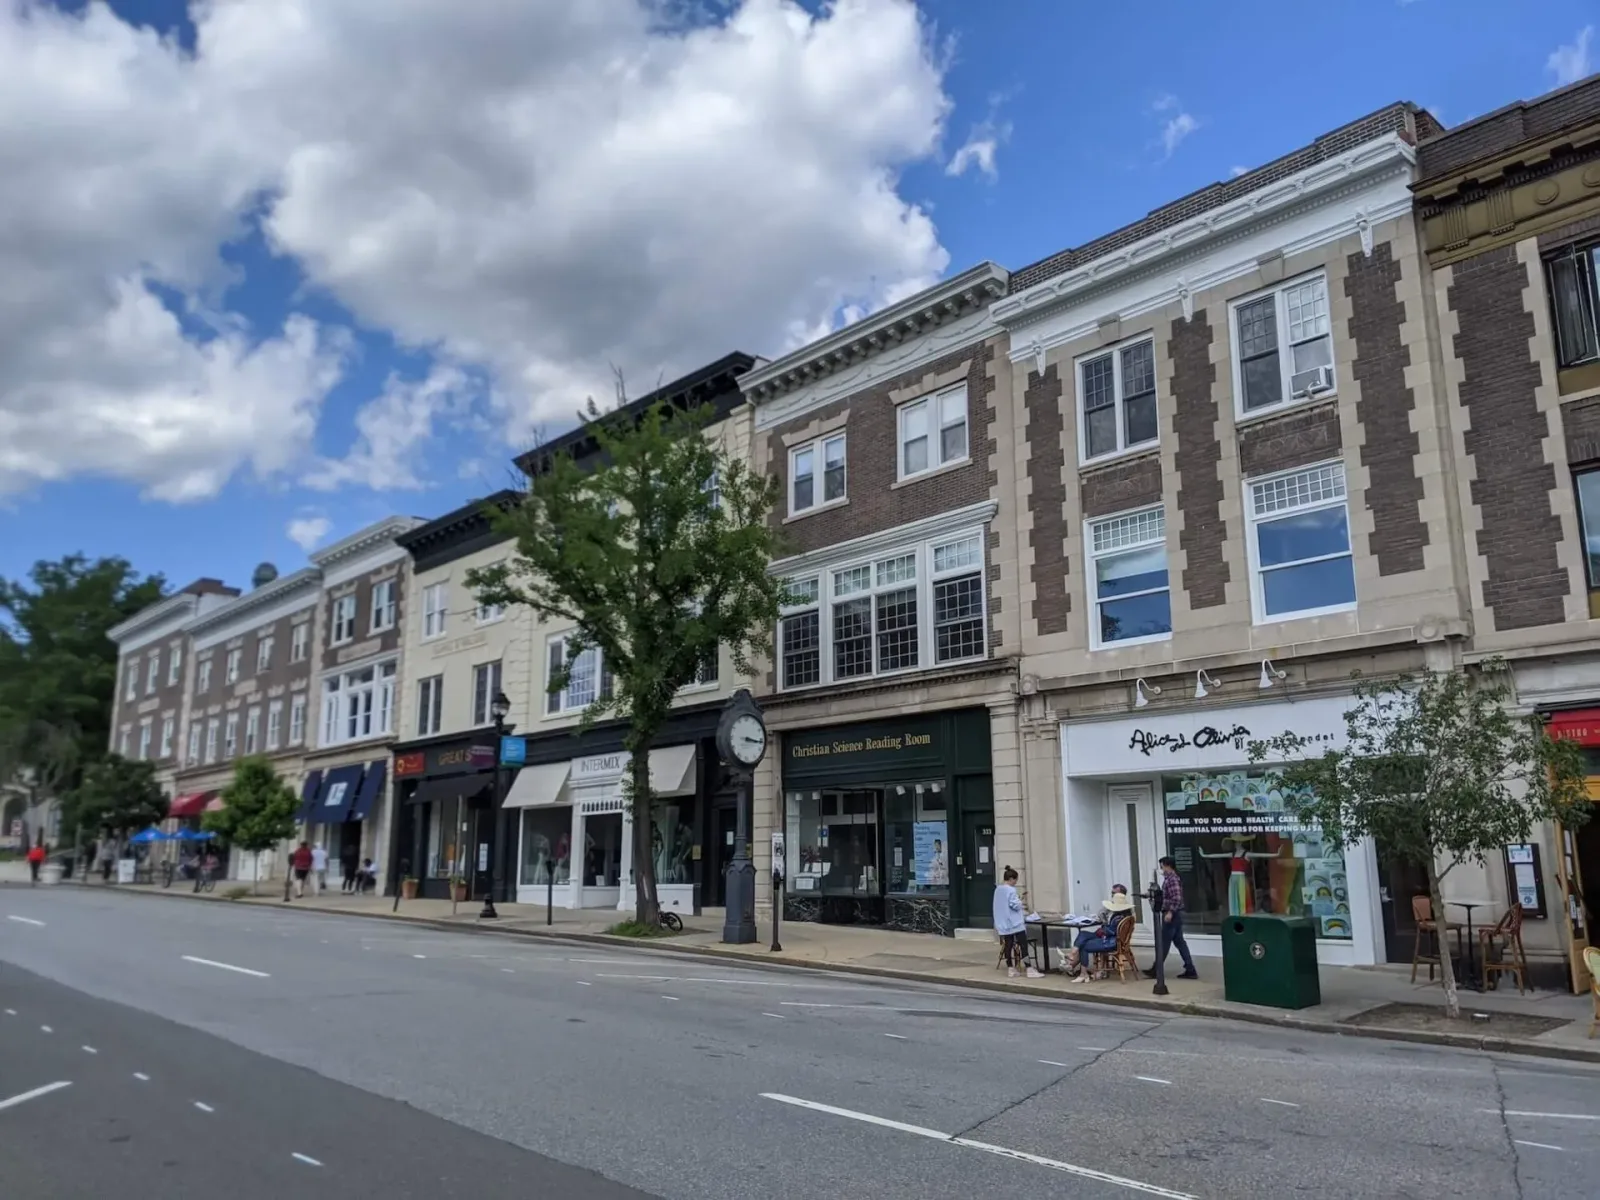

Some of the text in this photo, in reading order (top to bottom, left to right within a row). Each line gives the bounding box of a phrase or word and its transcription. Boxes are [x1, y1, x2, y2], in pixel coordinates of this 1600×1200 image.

[1129, 724, 1251, 756] Alice and Olivia
[1557, 728, 1588, 739] BISTRO
[792, 733, 931, 757] Christian Science Reading Room
[1234, 737, 1245, 750] BY
[581, 756, 620, 772] INTERMIX
[1246, 816, 1275, 824] HEALTH
[1278, 815, 1299, 823] CARE
[1248, 825, 1264, 833] FOR
[1265, 825, 1299, 833] KEEPING
